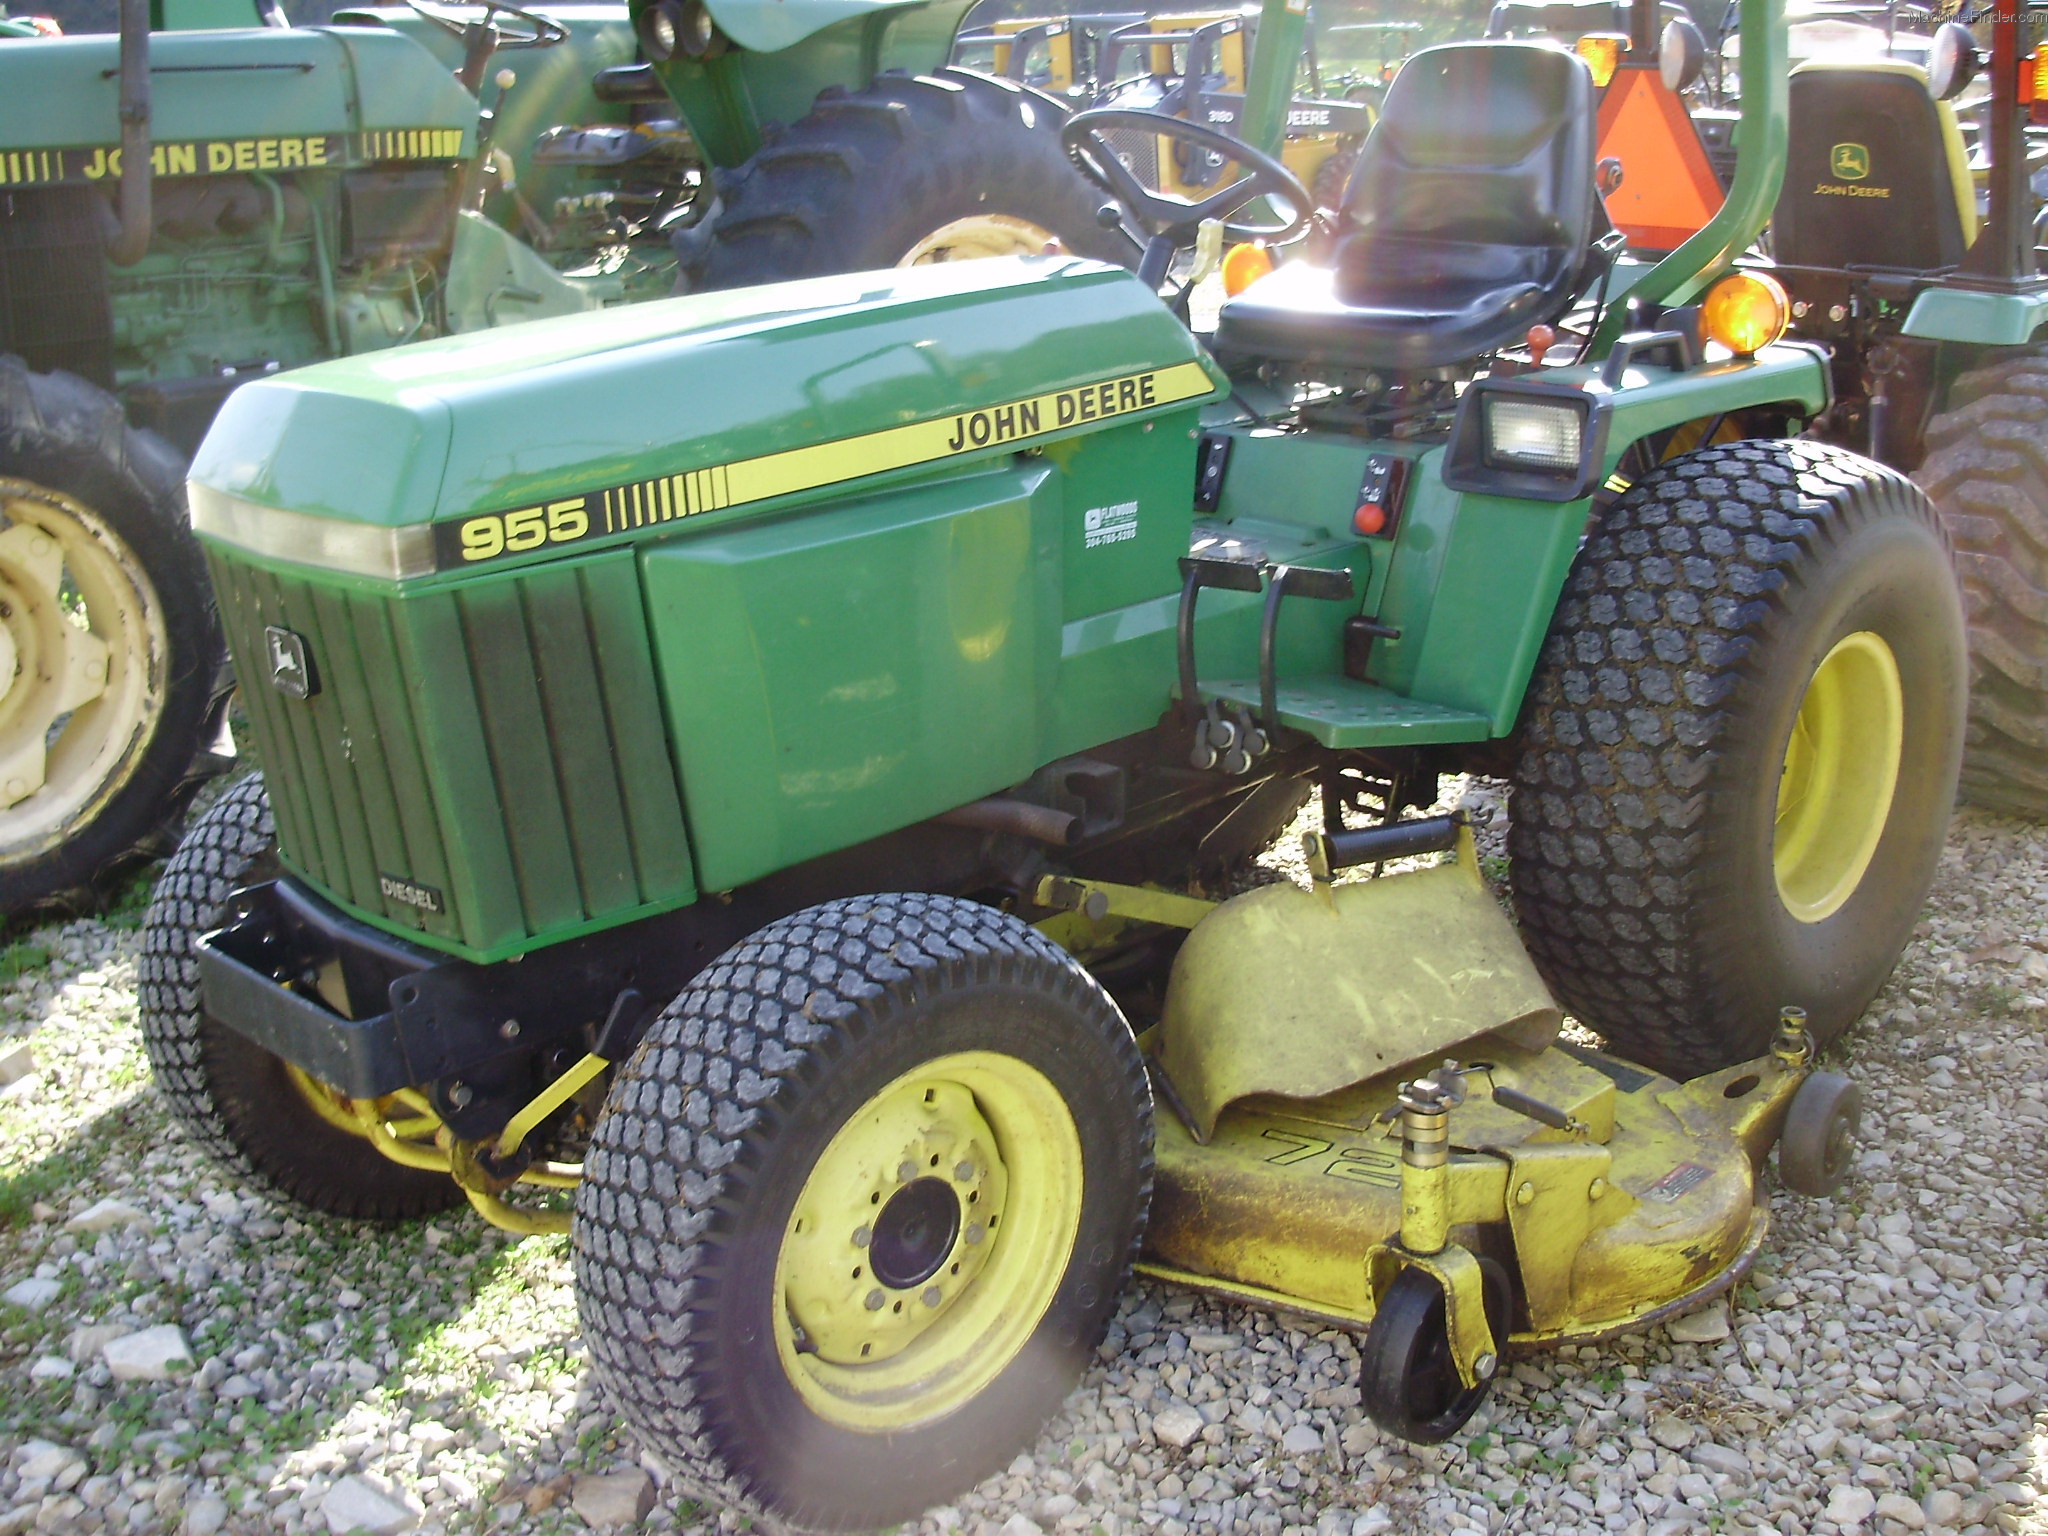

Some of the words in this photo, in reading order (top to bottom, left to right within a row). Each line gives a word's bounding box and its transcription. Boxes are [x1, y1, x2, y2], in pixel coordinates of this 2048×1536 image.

[207, 136, 327, 173] DEERE
[1813, 184, 1847, 196] JOHN
[1847, 184, 1890, 198] DEERE
[948, 400, 1040, 451] JOHN
[1056, 374, 1155, 426] DEERE
[461, 497, 589, 561] 955
[381, 877, 438, 912] DIESEL
[1260, 1128, 1401, 1190] 72
